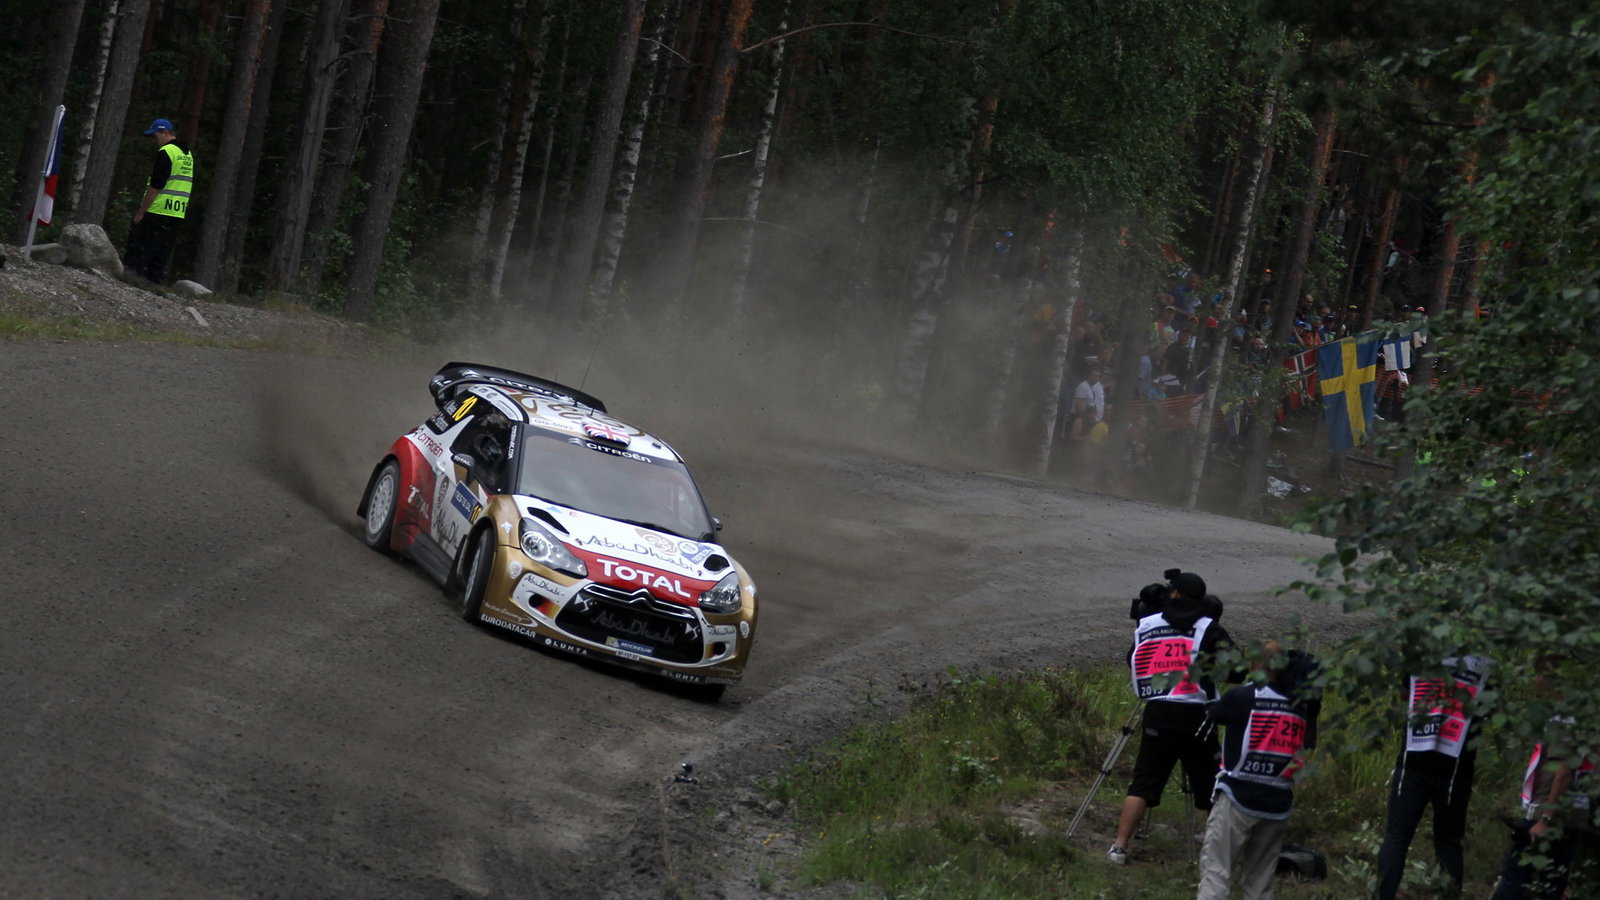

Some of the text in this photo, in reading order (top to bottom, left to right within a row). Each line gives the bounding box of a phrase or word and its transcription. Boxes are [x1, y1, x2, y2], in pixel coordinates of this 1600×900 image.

[452, 395, 478, 421] 10
[596, 558, 692, 599] TOTAL
[480, 613, 536, 639] EURODATACAR
[553, 640, 588, 656] LUHTA
[620, 641, 653, 654] MICHELIN
[668, 670, 700, 683] LUHTA
[1244, 760, 1275, 774] 2013
